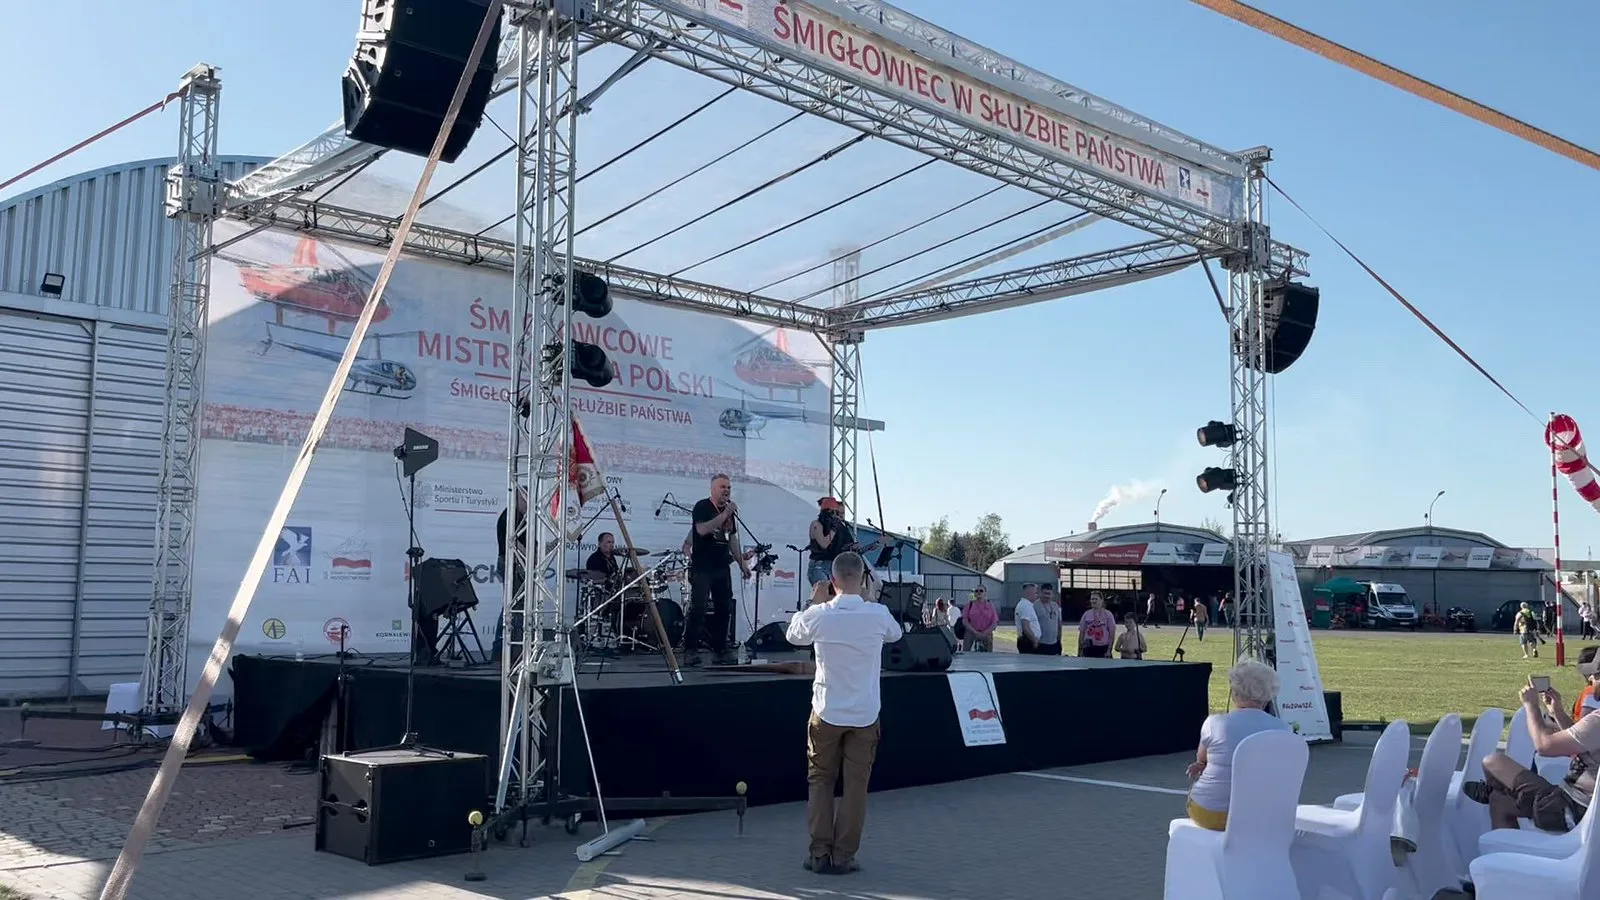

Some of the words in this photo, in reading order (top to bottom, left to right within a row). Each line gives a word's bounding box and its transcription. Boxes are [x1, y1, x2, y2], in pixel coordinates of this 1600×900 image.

[773, 0, 946, 104] ŚMIGŁOWIEC
[951, 81, 973, 114] W
[979, 93, 1071, 152] SŁUŻBIE
[1075, 131, 1166, 189] PAŃSTWA
[418, 330, 623, 387] MISTRA
[630, 363, 714, 398] POLSKI
[571, 397, 627, 417] SŁUŻBIE
[630, 403, 693, 424] PAŃSTWA
[434, 484, 483, 495] Ministerstwo
[434, 495, 460, 504] Sportu
[466, 496, 498, 507] Turystyki
[273, 567, 311, 584] FAI
